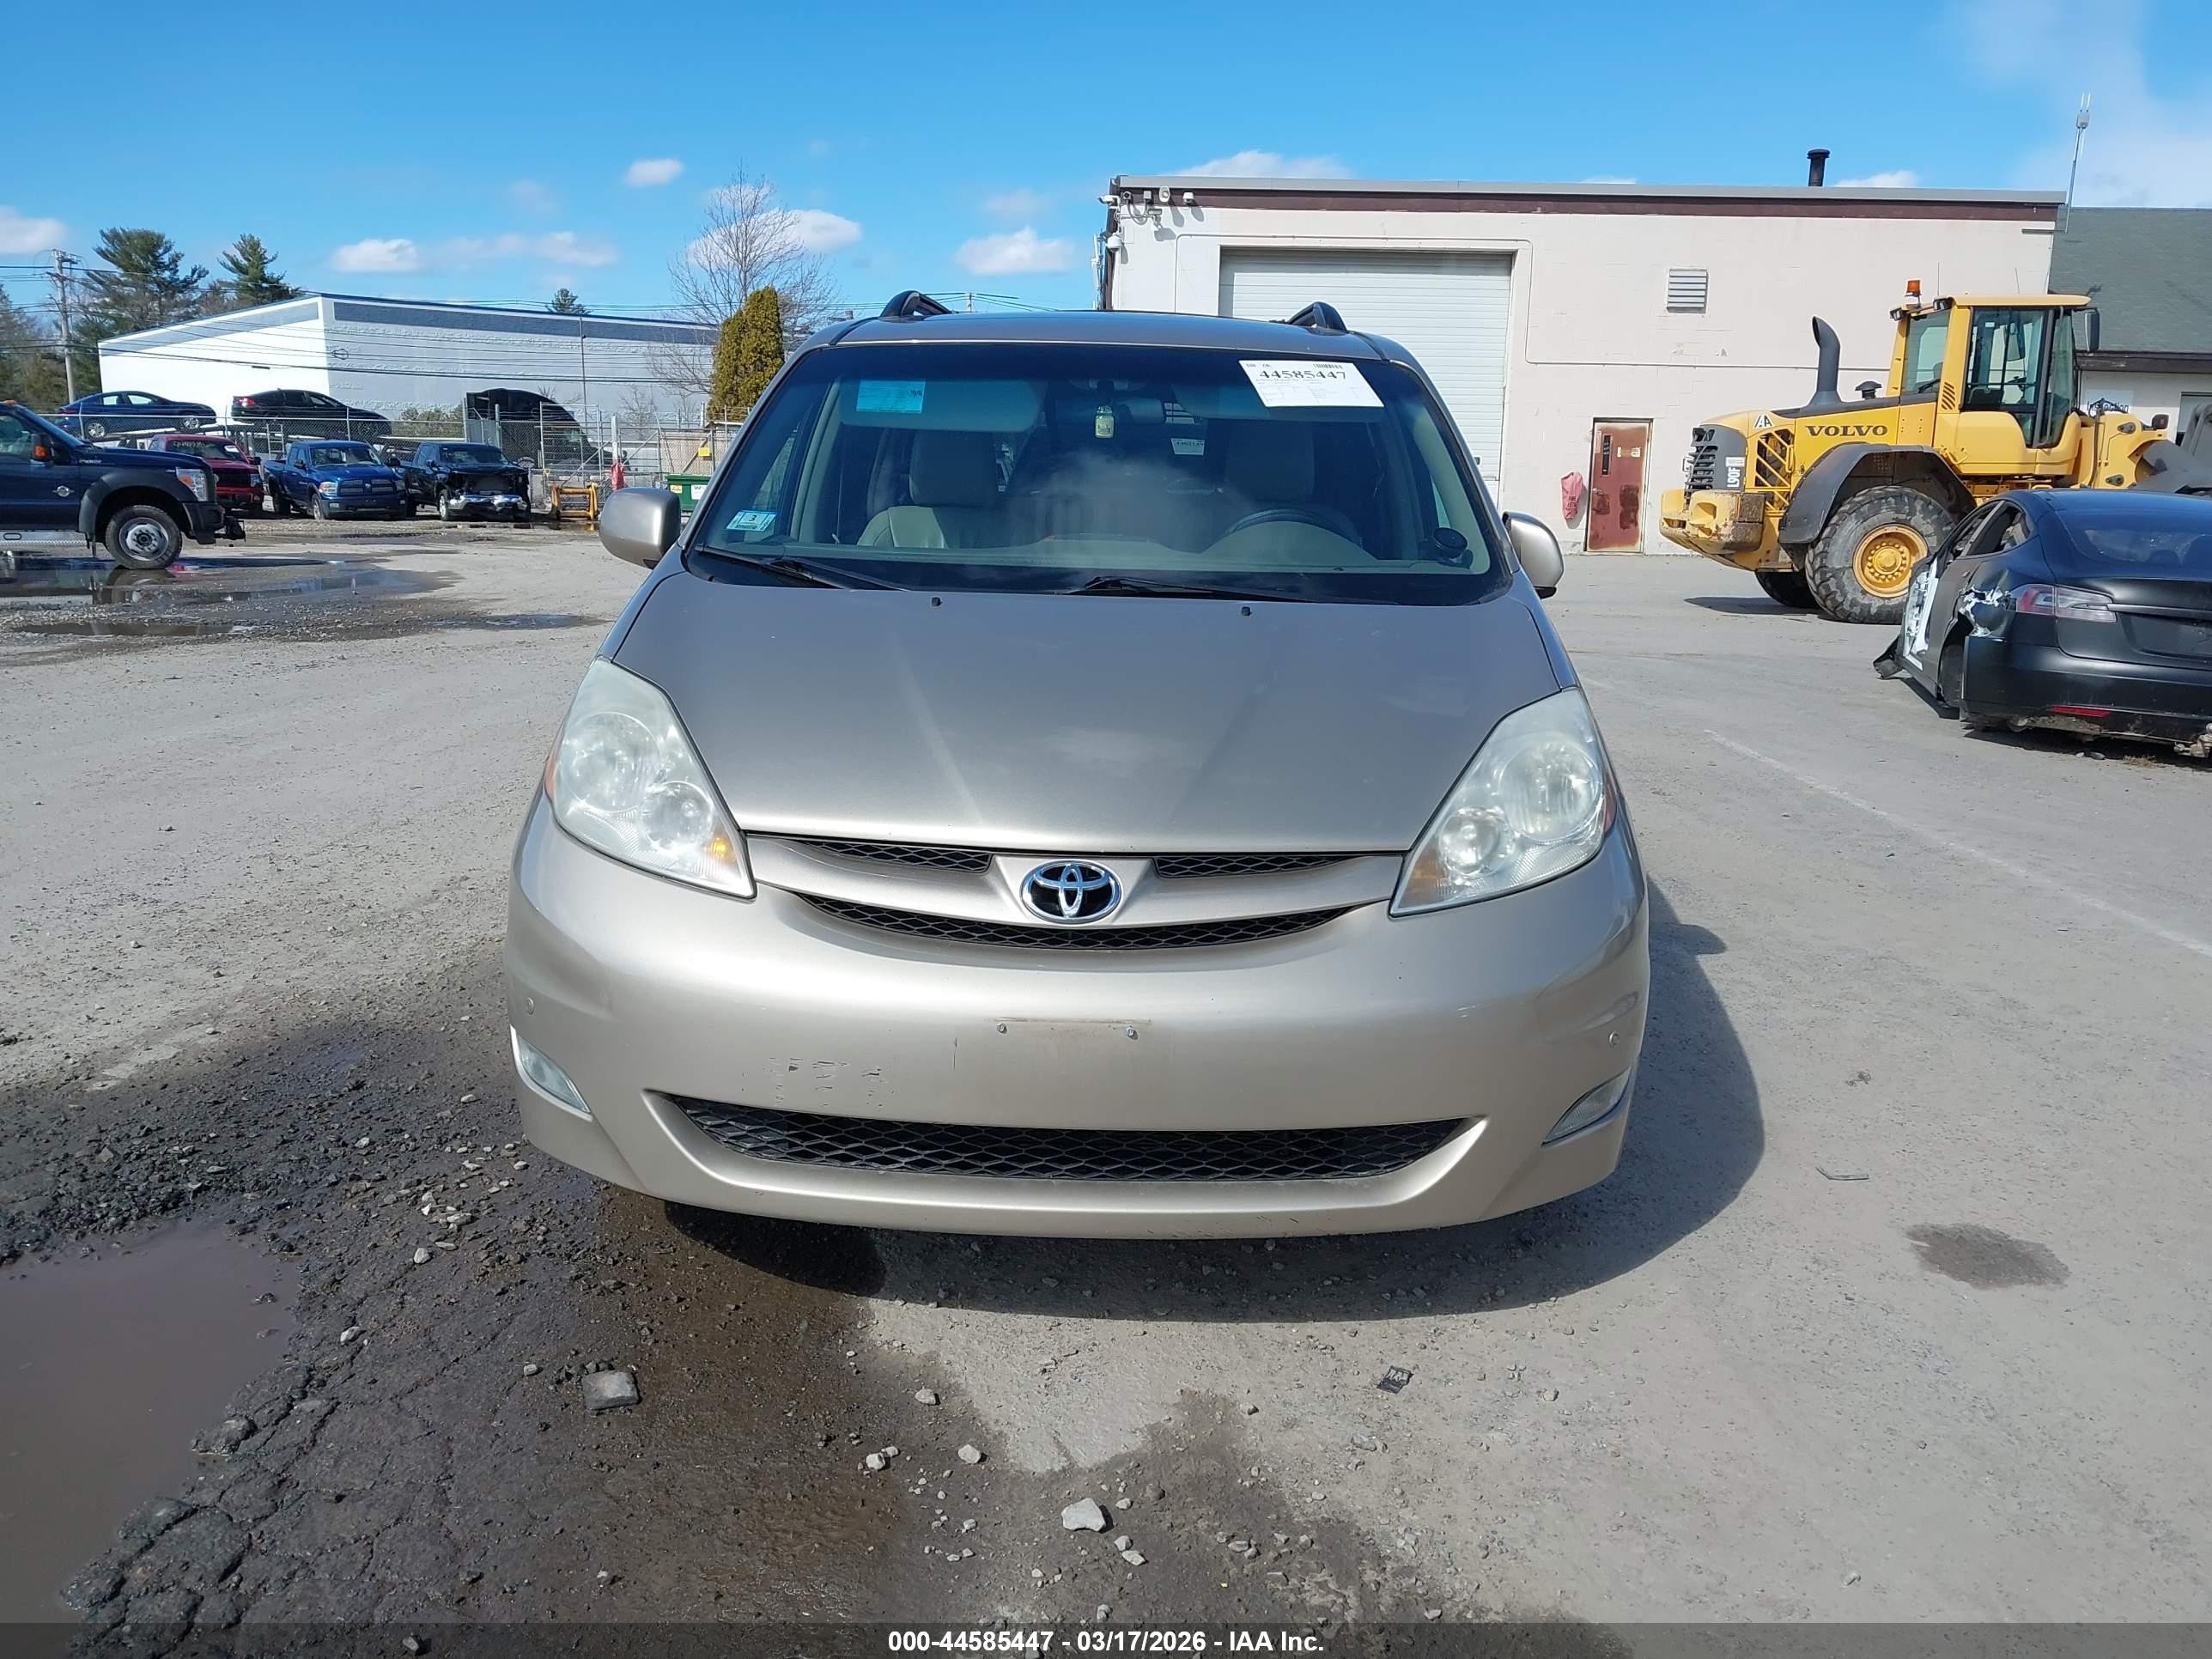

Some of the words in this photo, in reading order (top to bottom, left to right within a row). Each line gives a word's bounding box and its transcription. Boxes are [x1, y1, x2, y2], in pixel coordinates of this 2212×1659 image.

[1260, 370, 1346, 380] 44585447
[2087, 400, 2129, 413] Insection
[1805, 425, 1888, 436] VOLVO
[1727, 467, 1741, 488] L90F
